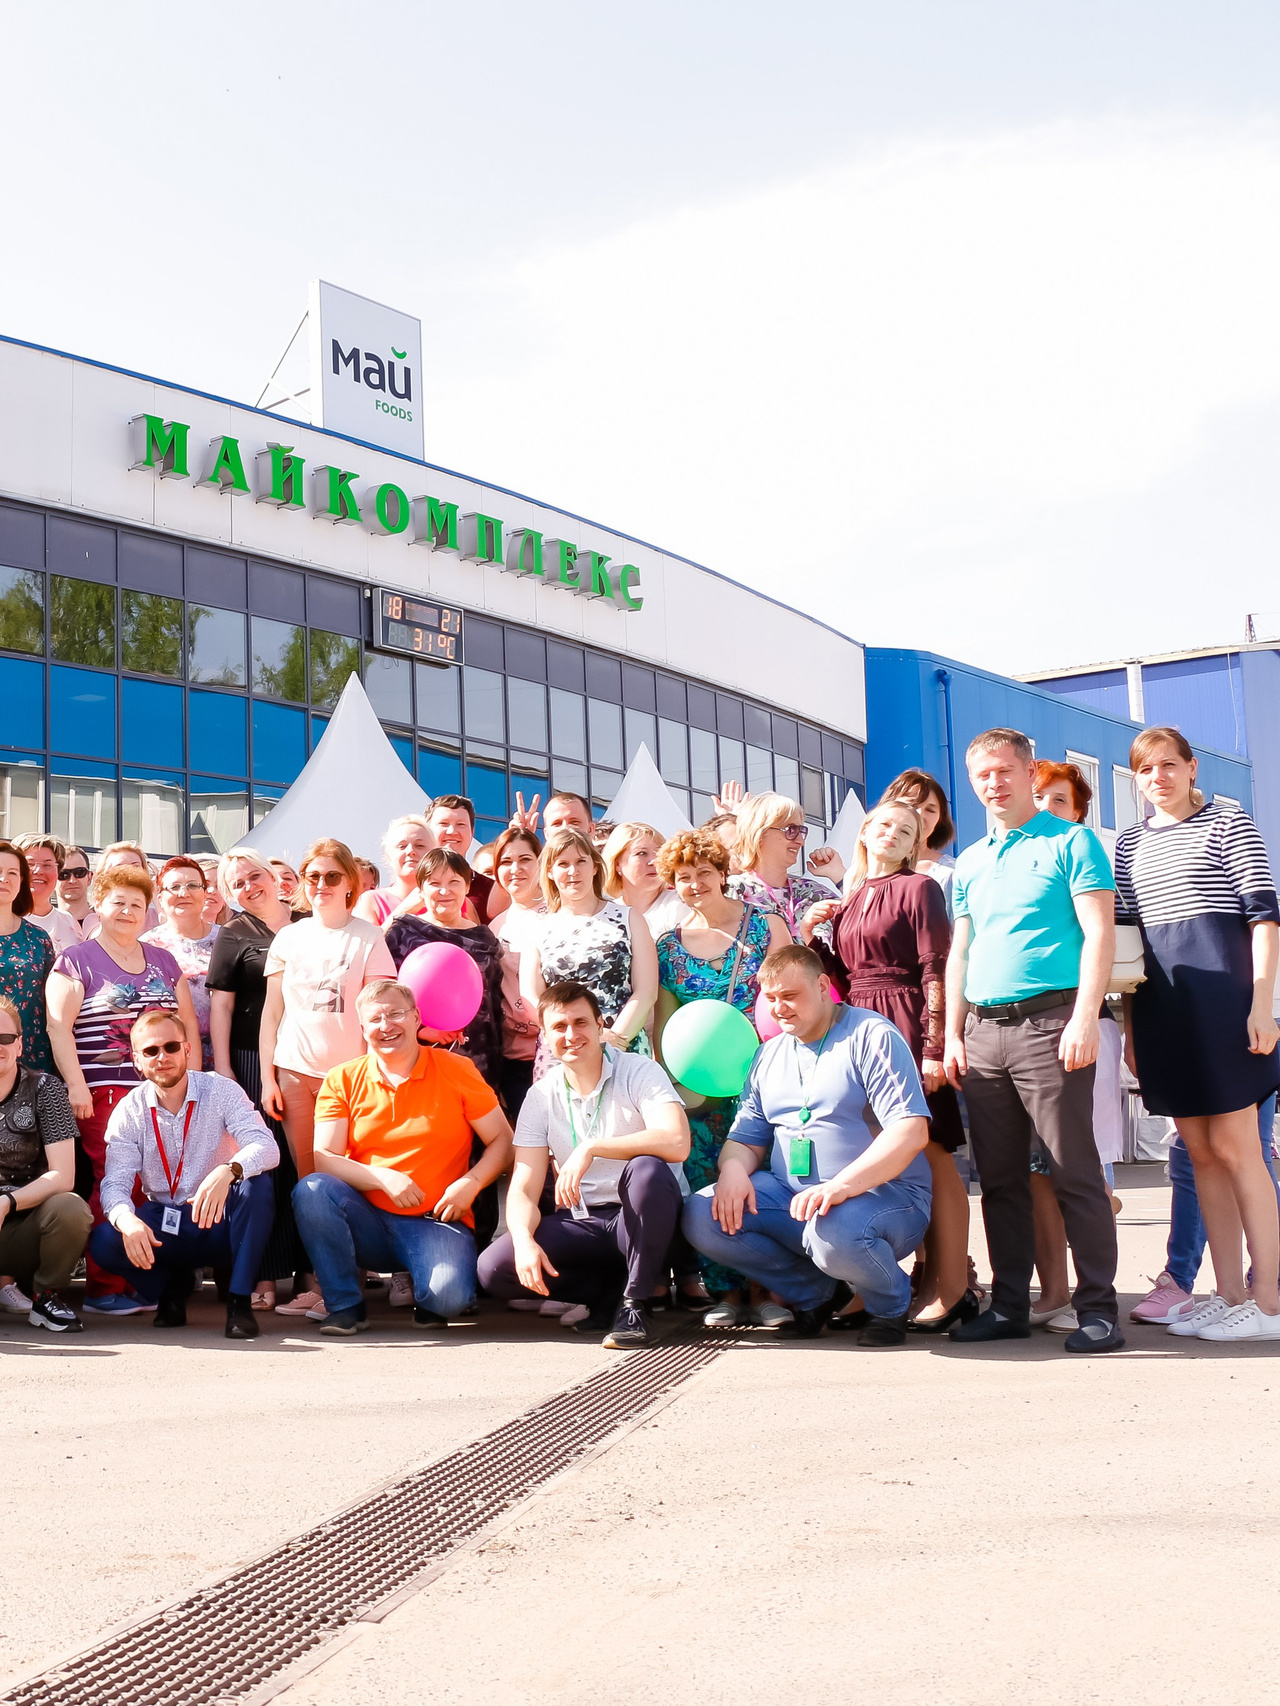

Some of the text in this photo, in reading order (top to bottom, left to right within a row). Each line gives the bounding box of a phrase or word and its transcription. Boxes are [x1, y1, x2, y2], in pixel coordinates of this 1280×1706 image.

[375, 399, 413, 422] FOODS
[142, 413, 644, 612] МАЙКОМПЛЕКС
[388, 596, 461, 633] 18 21
